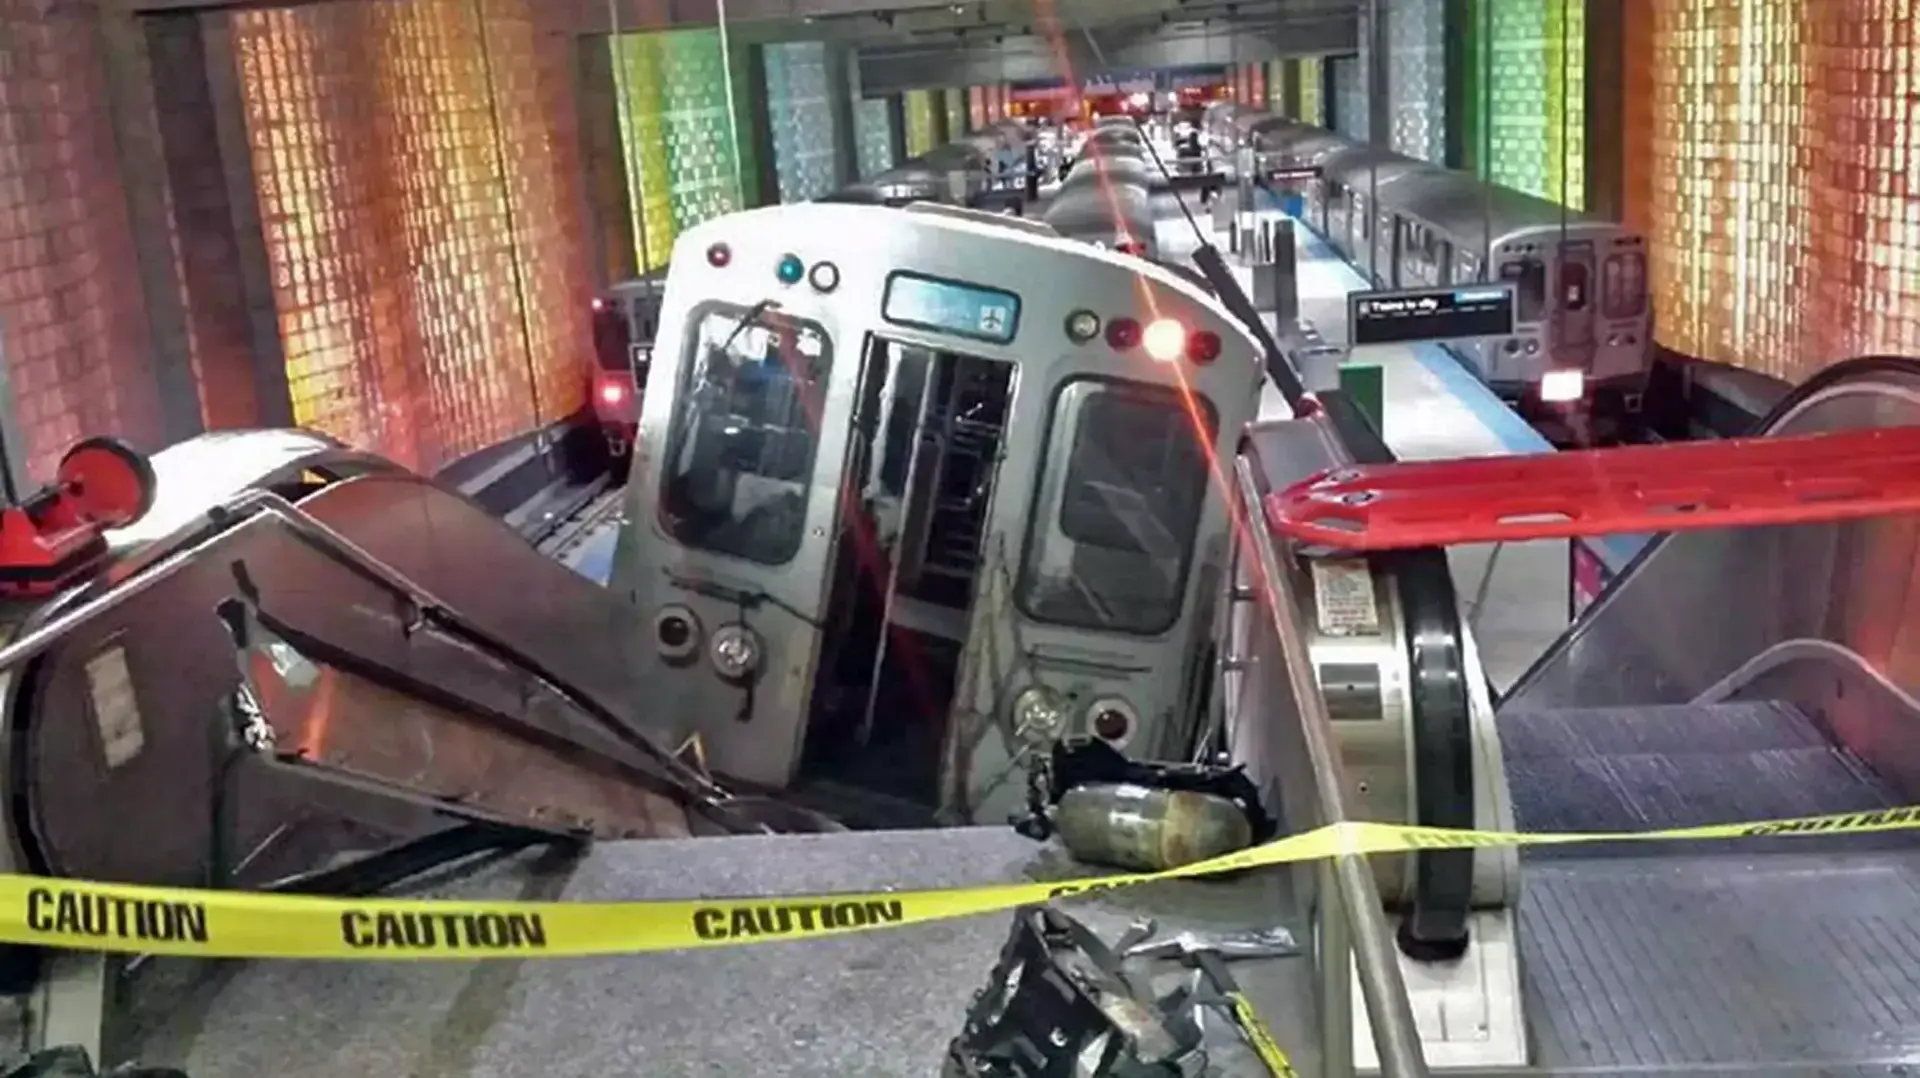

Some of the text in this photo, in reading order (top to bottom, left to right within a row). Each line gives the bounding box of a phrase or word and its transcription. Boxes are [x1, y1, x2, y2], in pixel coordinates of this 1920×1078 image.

[27, 887, 903, 949] CAUTION CAUTION CAUTION
